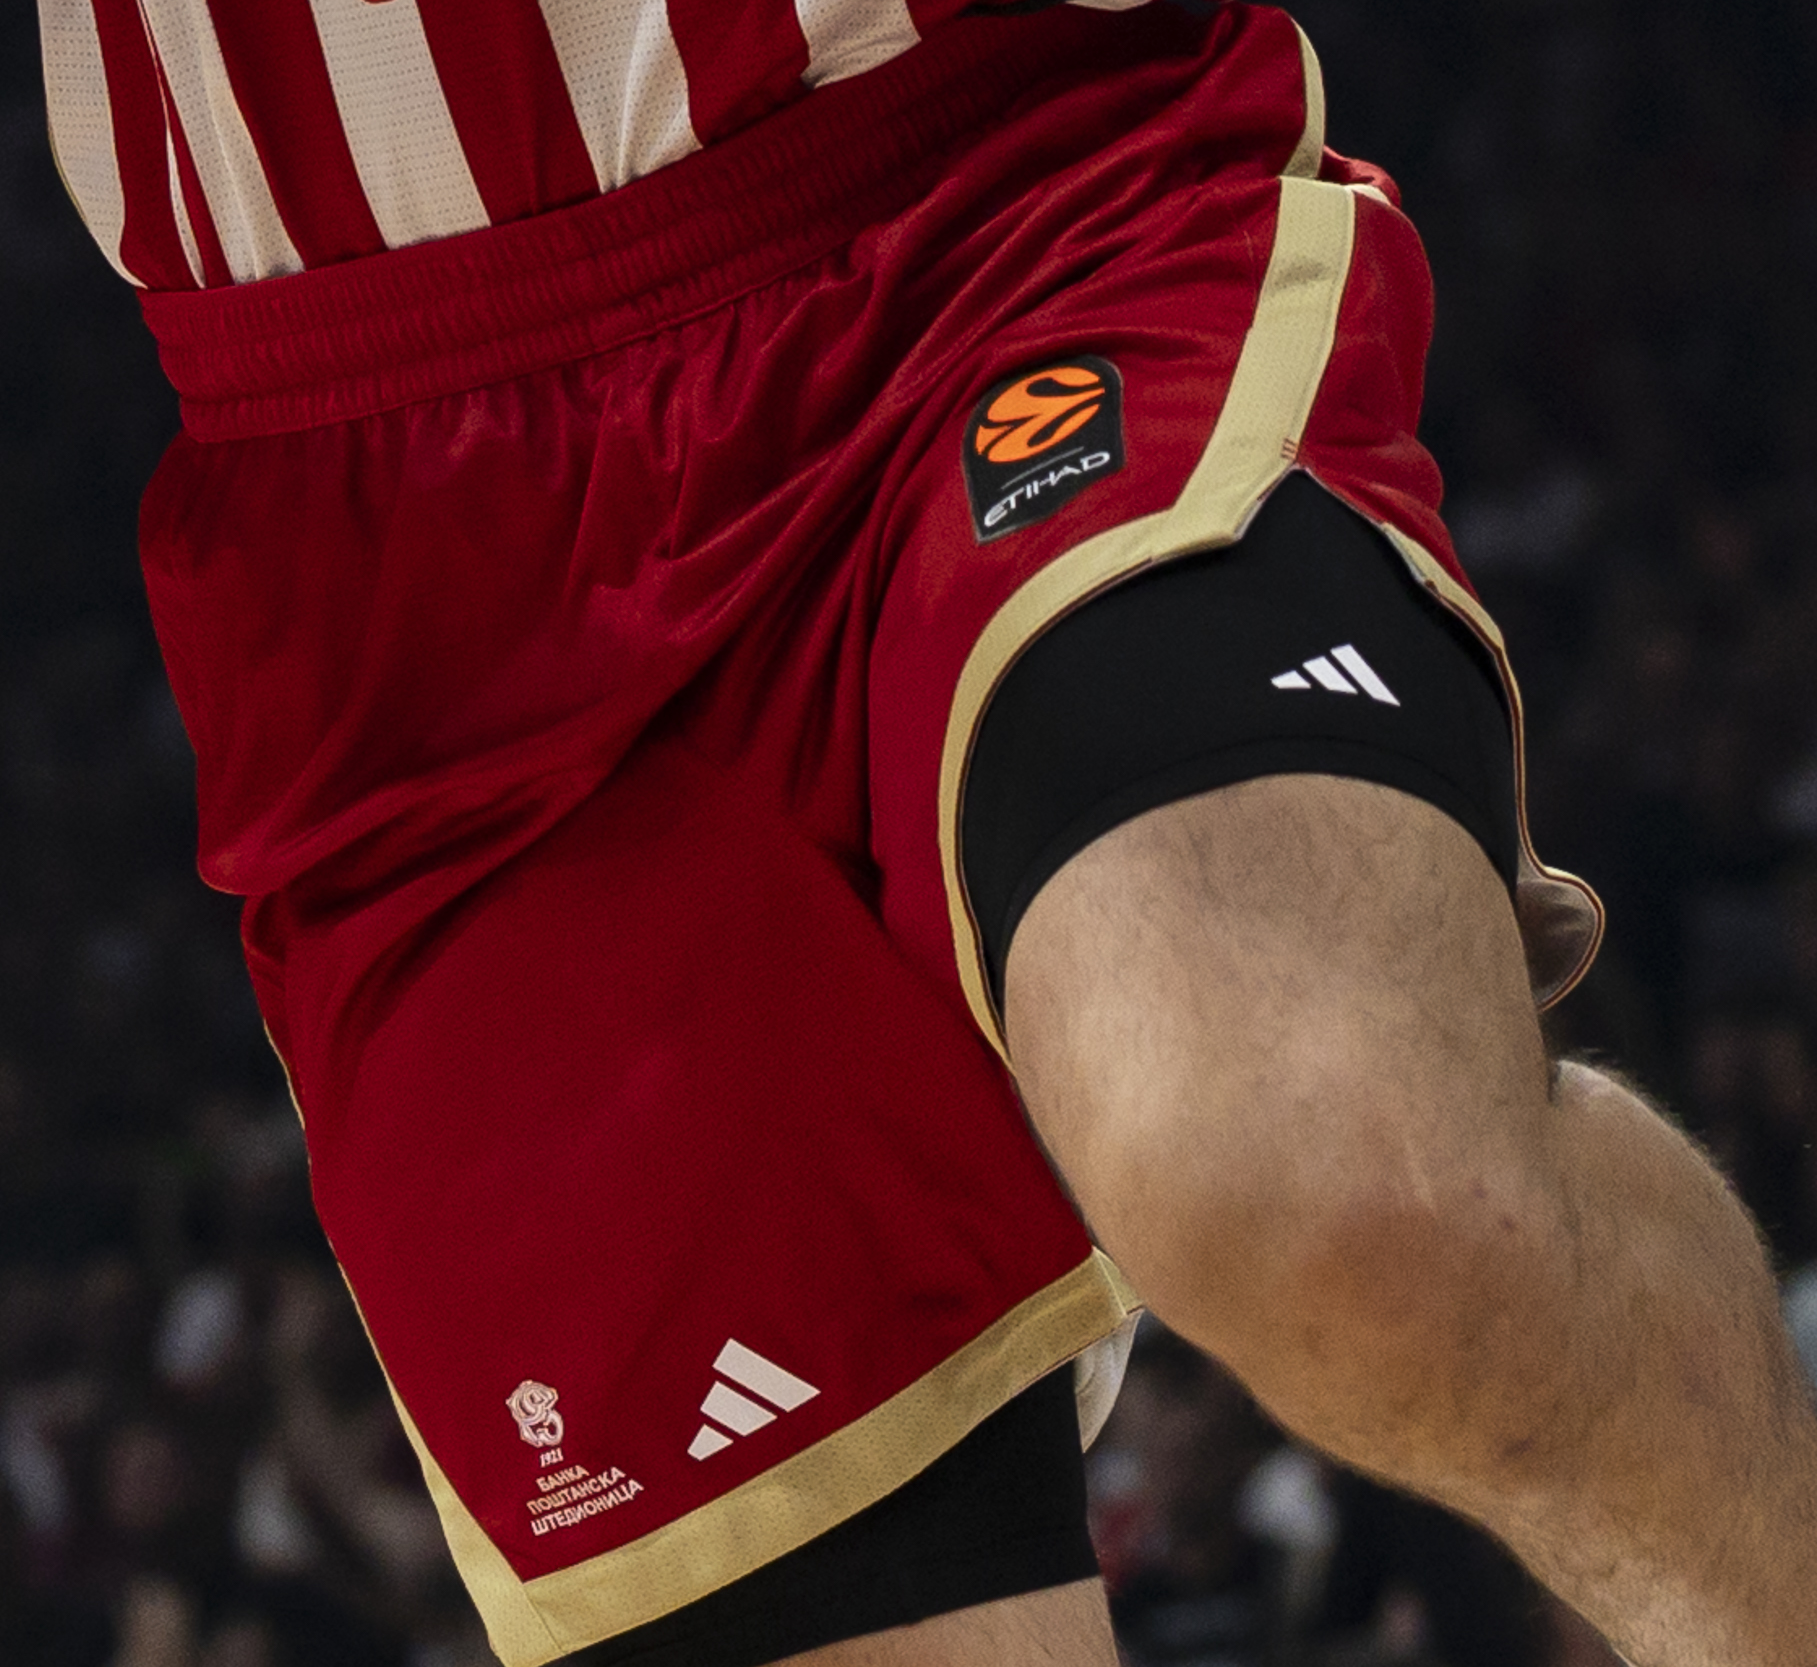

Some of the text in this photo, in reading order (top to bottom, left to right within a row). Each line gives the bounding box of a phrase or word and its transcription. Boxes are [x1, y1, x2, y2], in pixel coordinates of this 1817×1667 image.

[984, 451, 1110, 527] ETIHAD
[536, 1464, 590, 1493] БАНКА
[540, 1447, 564, 1468] 1921
[526, 1466, 627, 1515] ПОШТАНСКА
[530, 1478, 645, 1537] ШТЕДИОНИЦА
